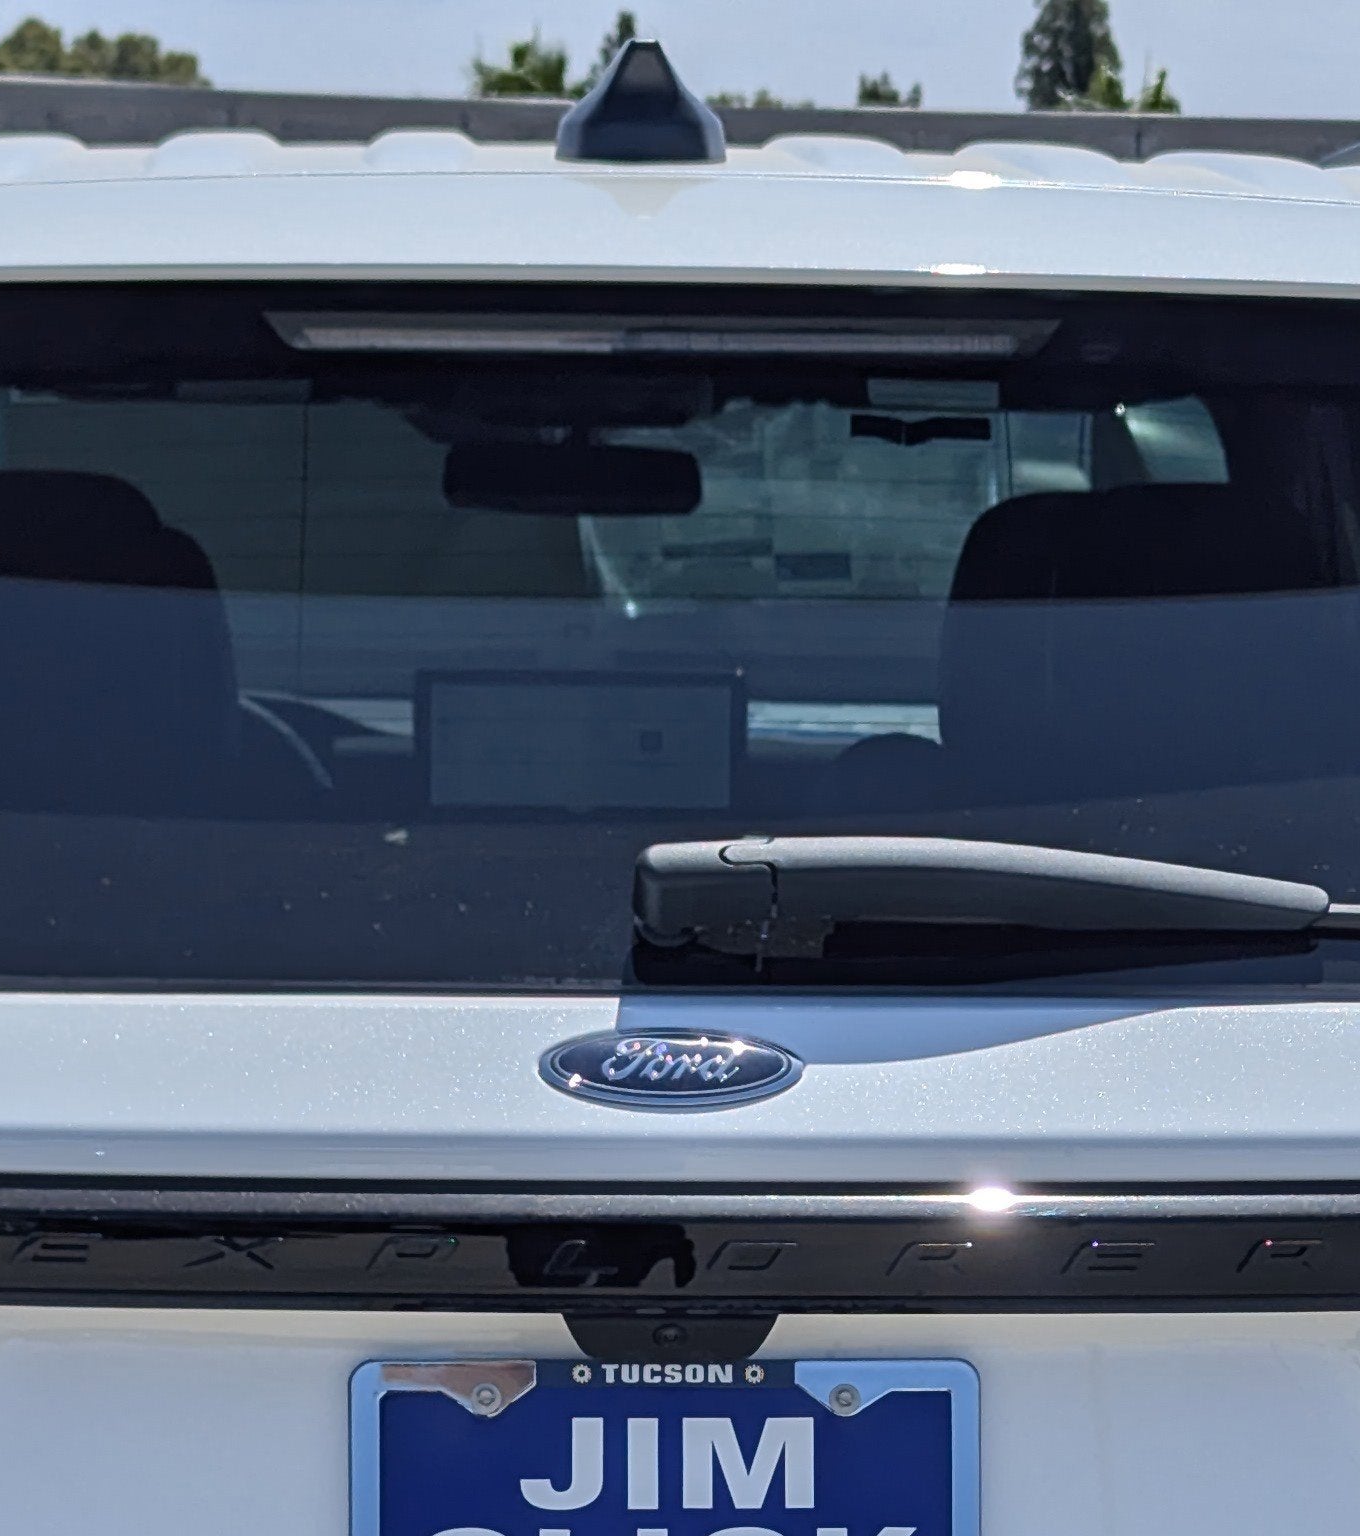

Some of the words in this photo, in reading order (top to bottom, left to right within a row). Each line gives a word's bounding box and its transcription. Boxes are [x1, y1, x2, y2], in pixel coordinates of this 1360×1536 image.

[601, 1037, 741, 1081] Ford
[6, 1234, 1324, 1280] EXPLORER
[601, 1363, 733, 1384] TUCSON
[520, 1417, 815, 1510] JIM
